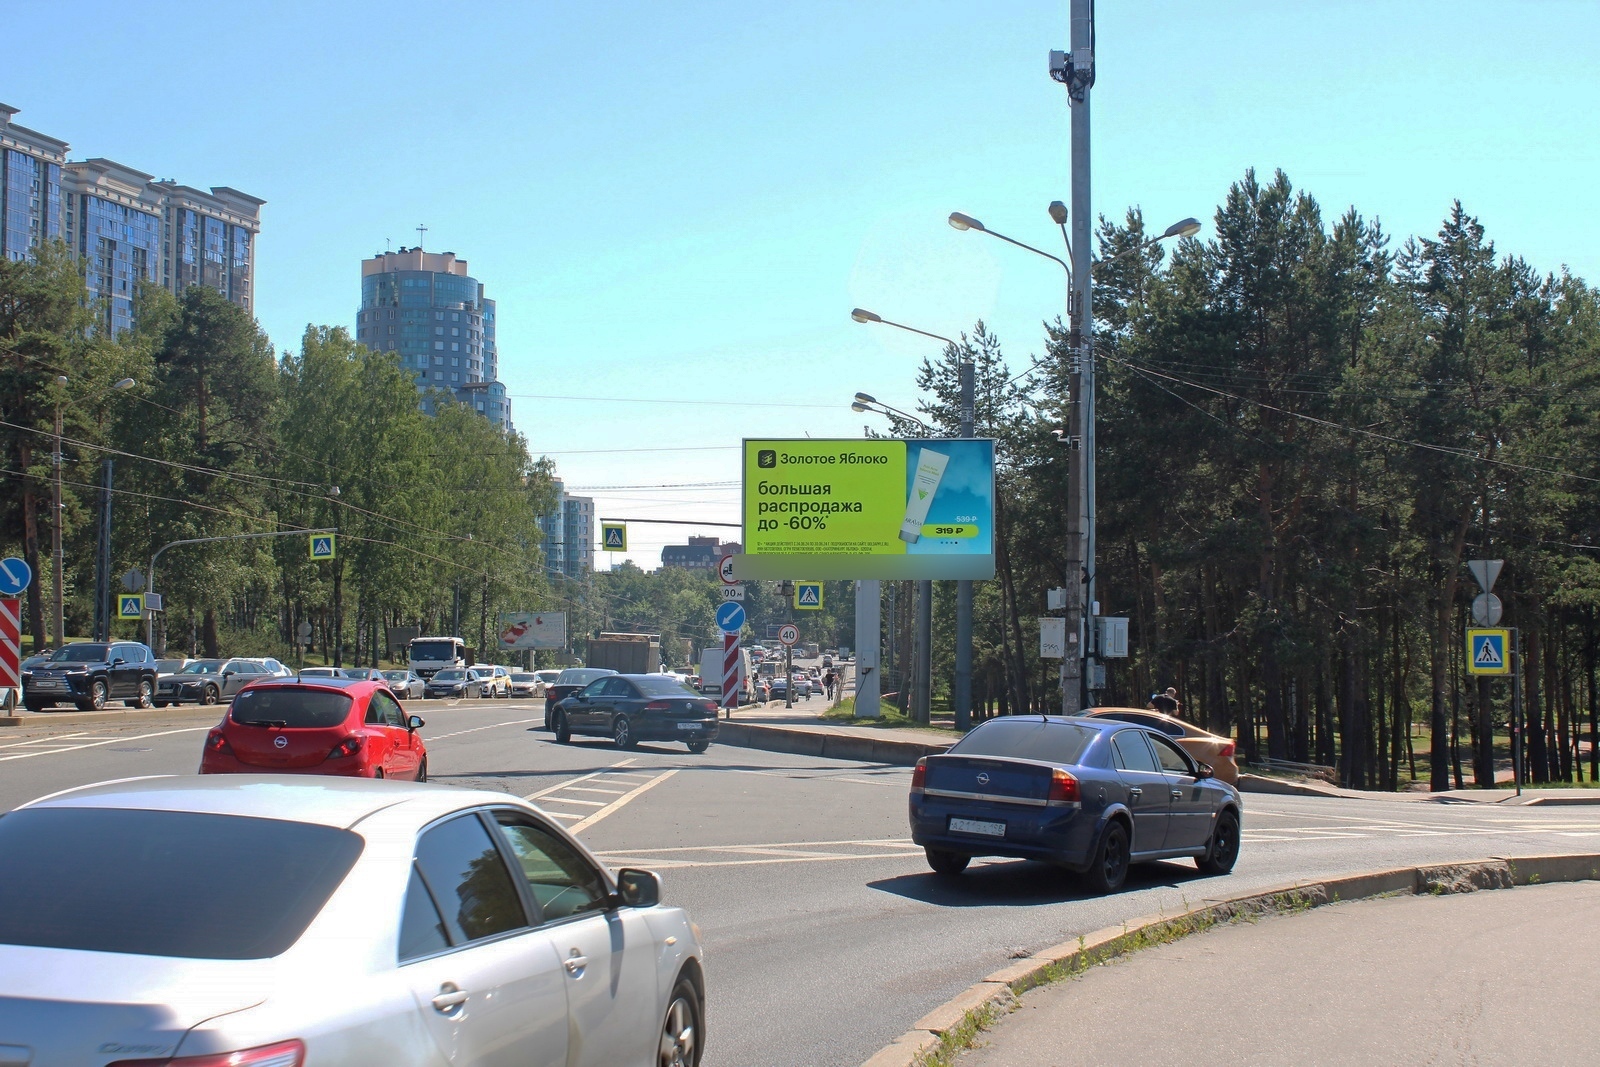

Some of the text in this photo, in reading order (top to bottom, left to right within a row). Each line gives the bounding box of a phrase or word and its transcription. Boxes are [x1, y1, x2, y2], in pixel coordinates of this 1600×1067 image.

[780, 452, 888, 464] Золотое Яблоко
[758, 480, 831, 495] большая
[758, 502, 862, 516] распродажа
[757, 519, 779, 532] до
[935, 527, 954, 535] 319
[782, 630, 795, 640] 40
